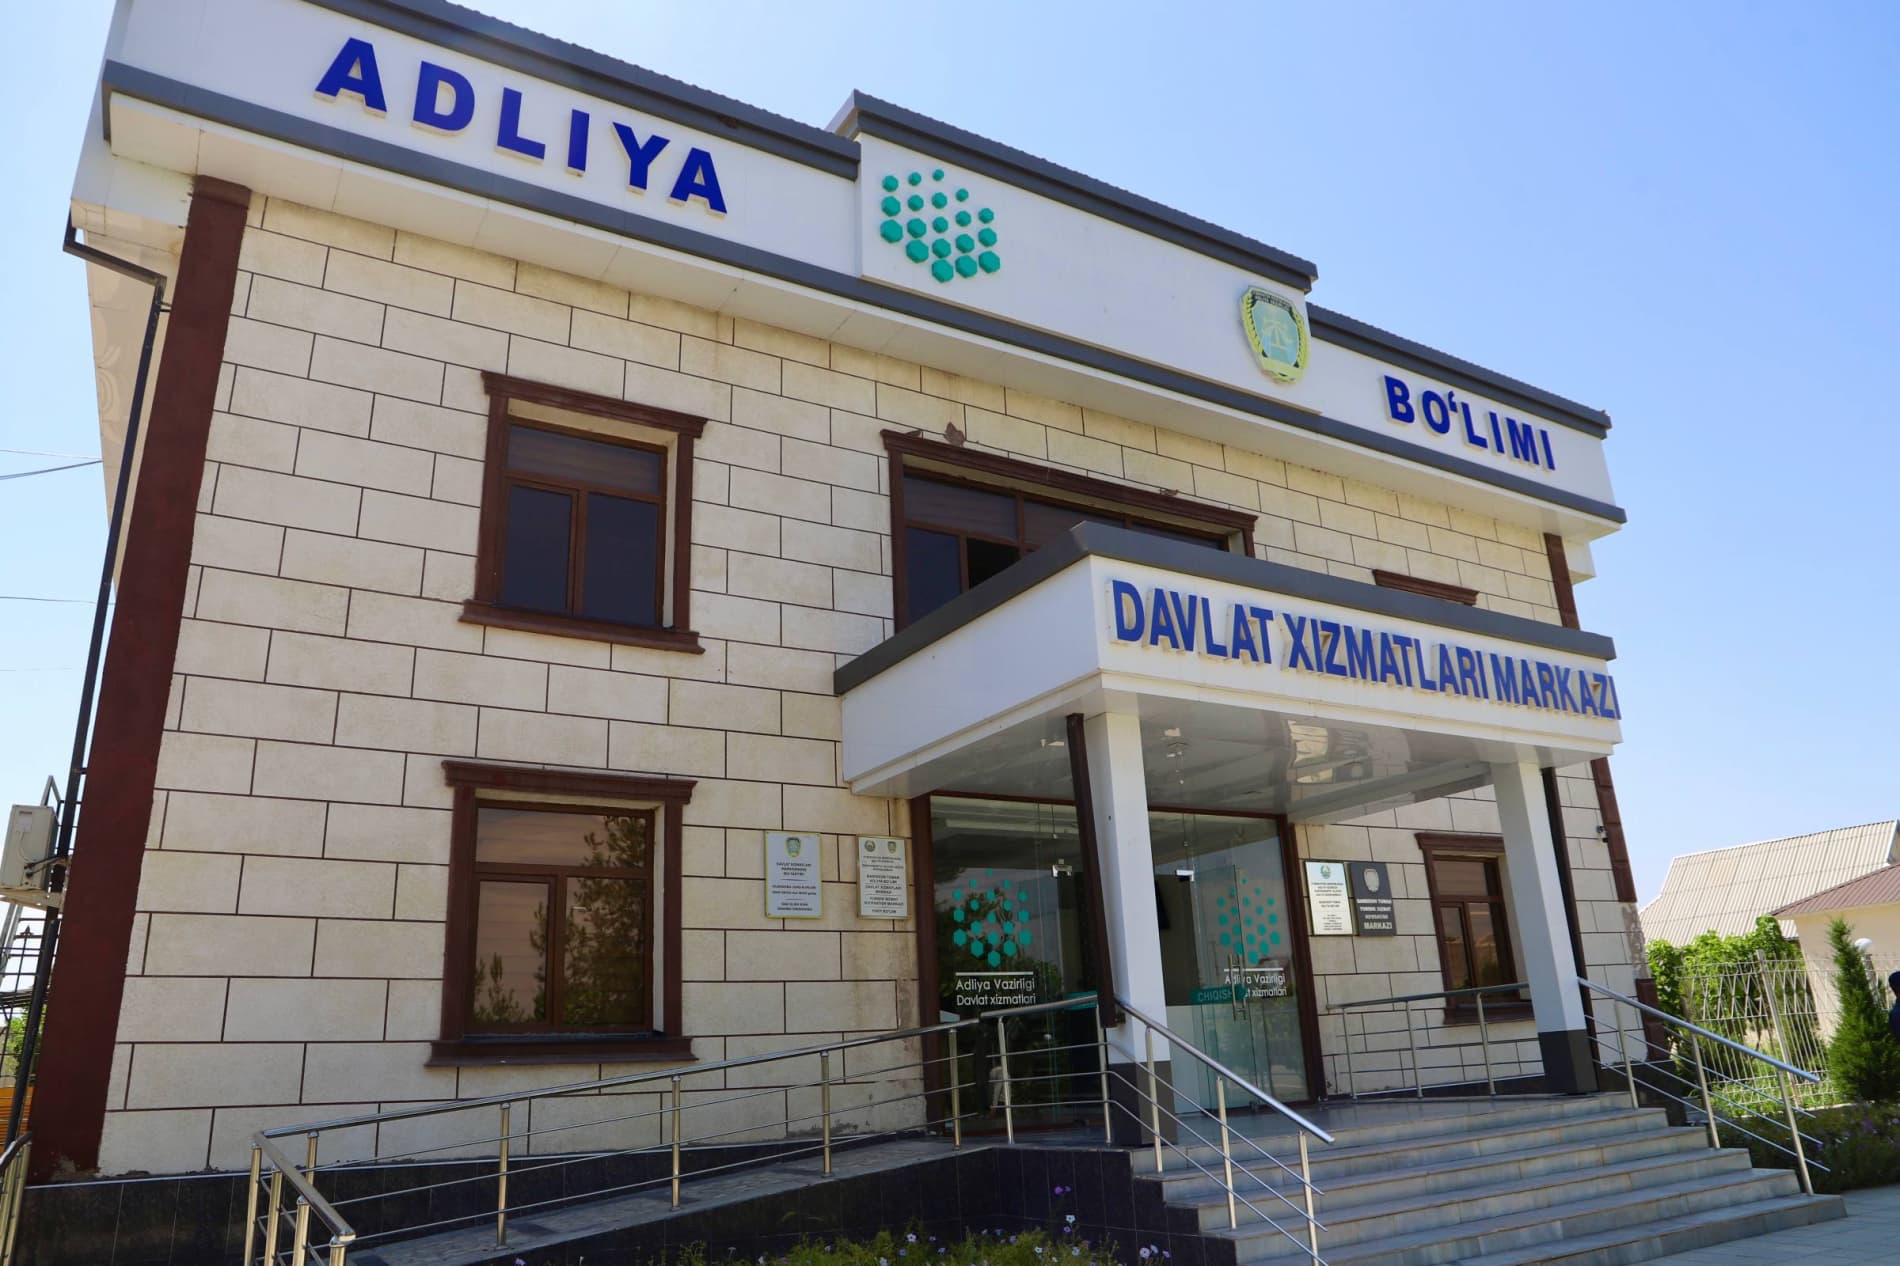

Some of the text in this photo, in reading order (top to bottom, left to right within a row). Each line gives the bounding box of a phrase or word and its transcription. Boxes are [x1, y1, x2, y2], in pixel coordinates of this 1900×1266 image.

[315, 37, 728, 214] ADLIYA
[1111, 579, 1622, 720] DAVLAT XIZMATLARI MARKAZI
[955, 977, 1035, 992] Adliya Vazirligi
[956, 993, 1036, 1006] Davlat xizmatlari
